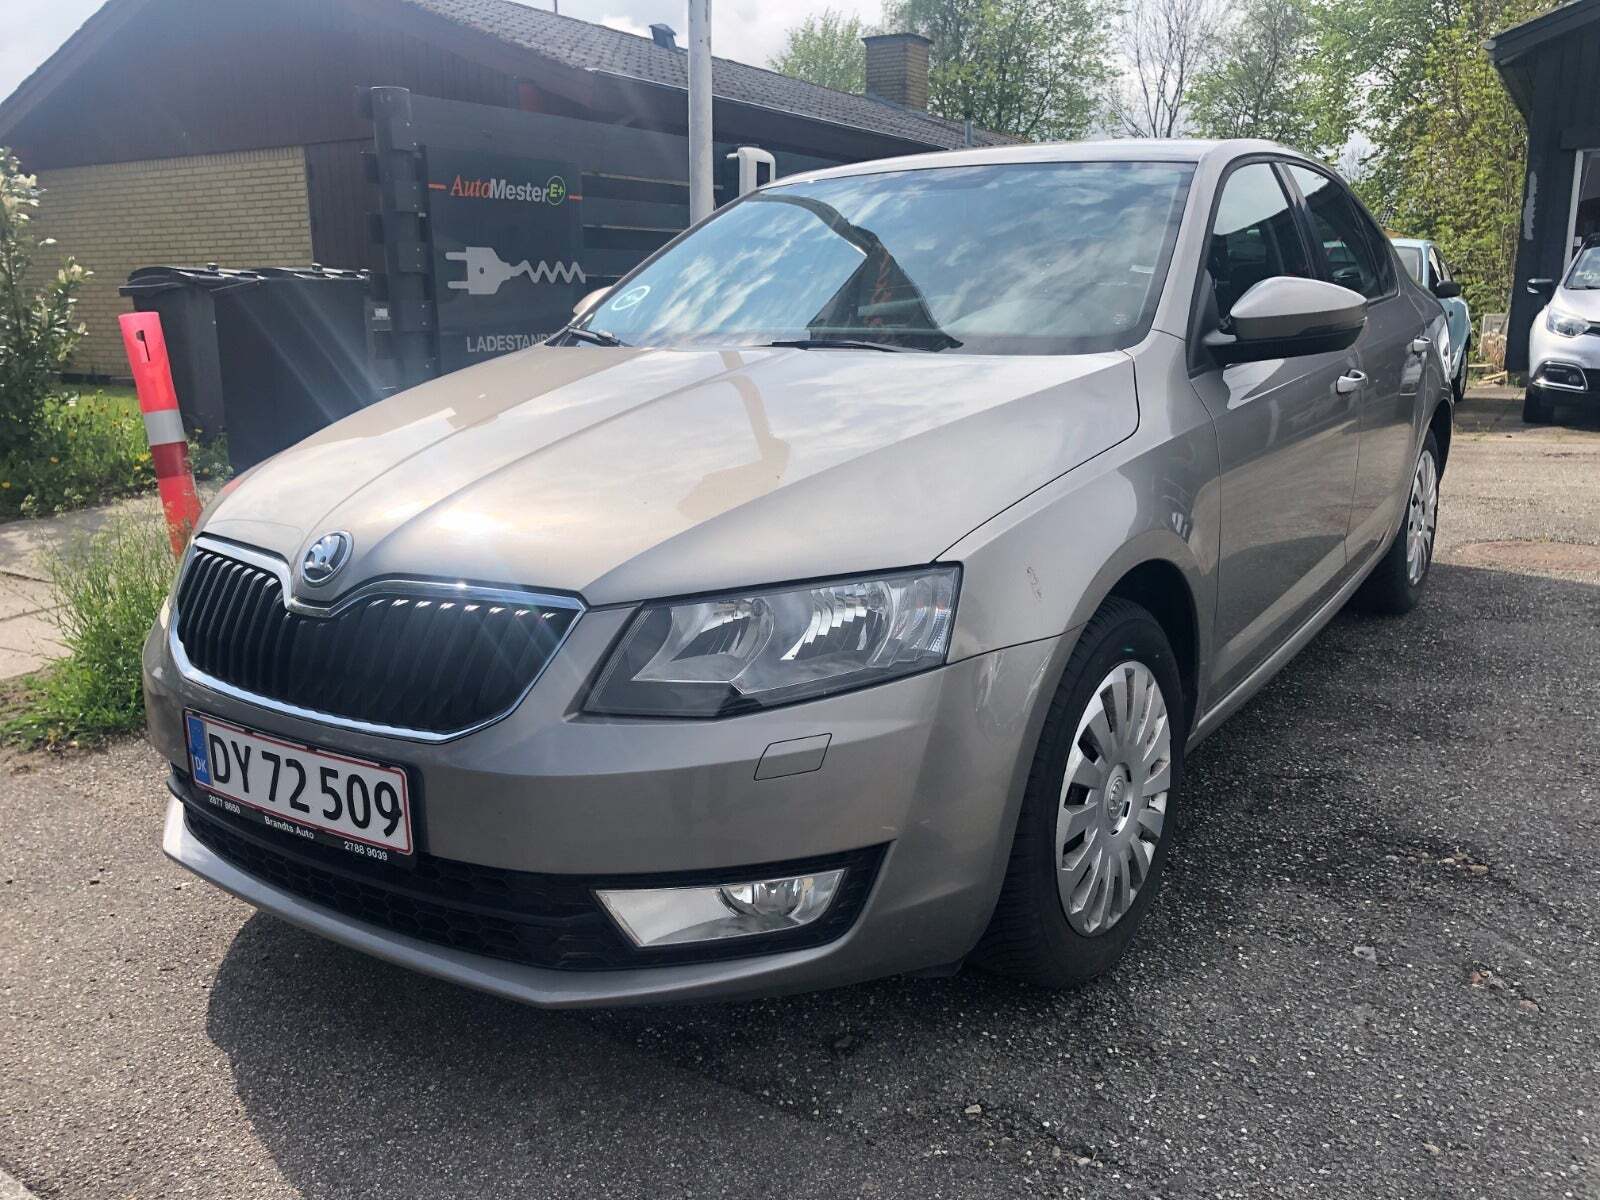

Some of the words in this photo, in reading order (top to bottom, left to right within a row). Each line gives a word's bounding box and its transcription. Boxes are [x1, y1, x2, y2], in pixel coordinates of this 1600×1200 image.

[194, 756, 207, 774] DK
[208, 733, 251, 794] DY
[261, 751, 310, 814] 72
[319, 766, 403, 837] 509
[264, 815, 294, 833] Brandts
[296, 825, 315, 840] Auto
[343, 840, 365, 855] 2788
[366, 847, 388, 861] 9039
